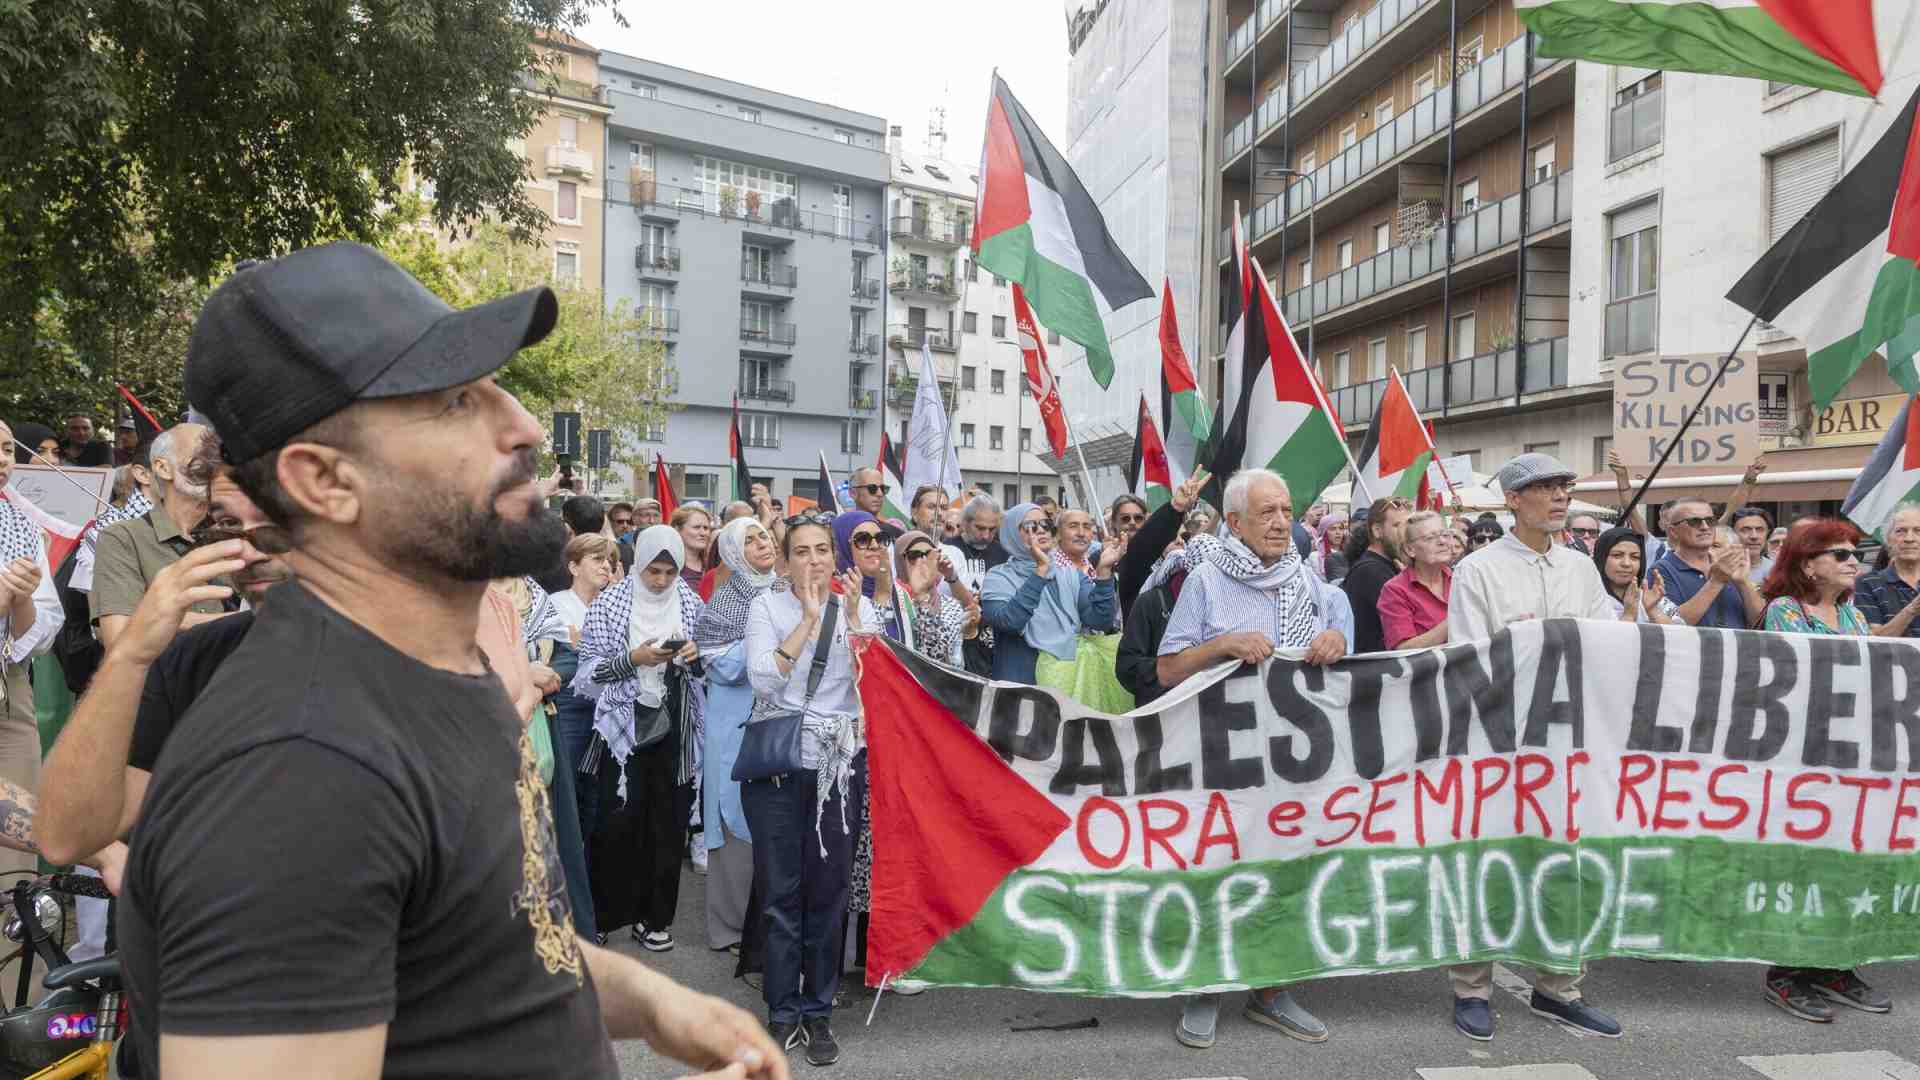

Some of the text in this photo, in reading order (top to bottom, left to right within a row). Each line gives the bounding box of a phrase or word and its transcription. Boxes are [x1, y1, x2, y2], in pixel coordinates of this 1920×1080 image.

[1622, 356, 1745, 397] STOP
[1621, 402, 1755, 429] KILLING
[1816, 400, 1882, 435] BAR
[1649, 434, 1736, 464] KIDS
[987, 618, 1585, 797] PALESTINA
[1076, 791, 1241, 870] ORA
[1268, 800, 1306, 837] e
[1744, 880, 1825, 917] CSA
[1003, 871, 1271, 986] STOP
